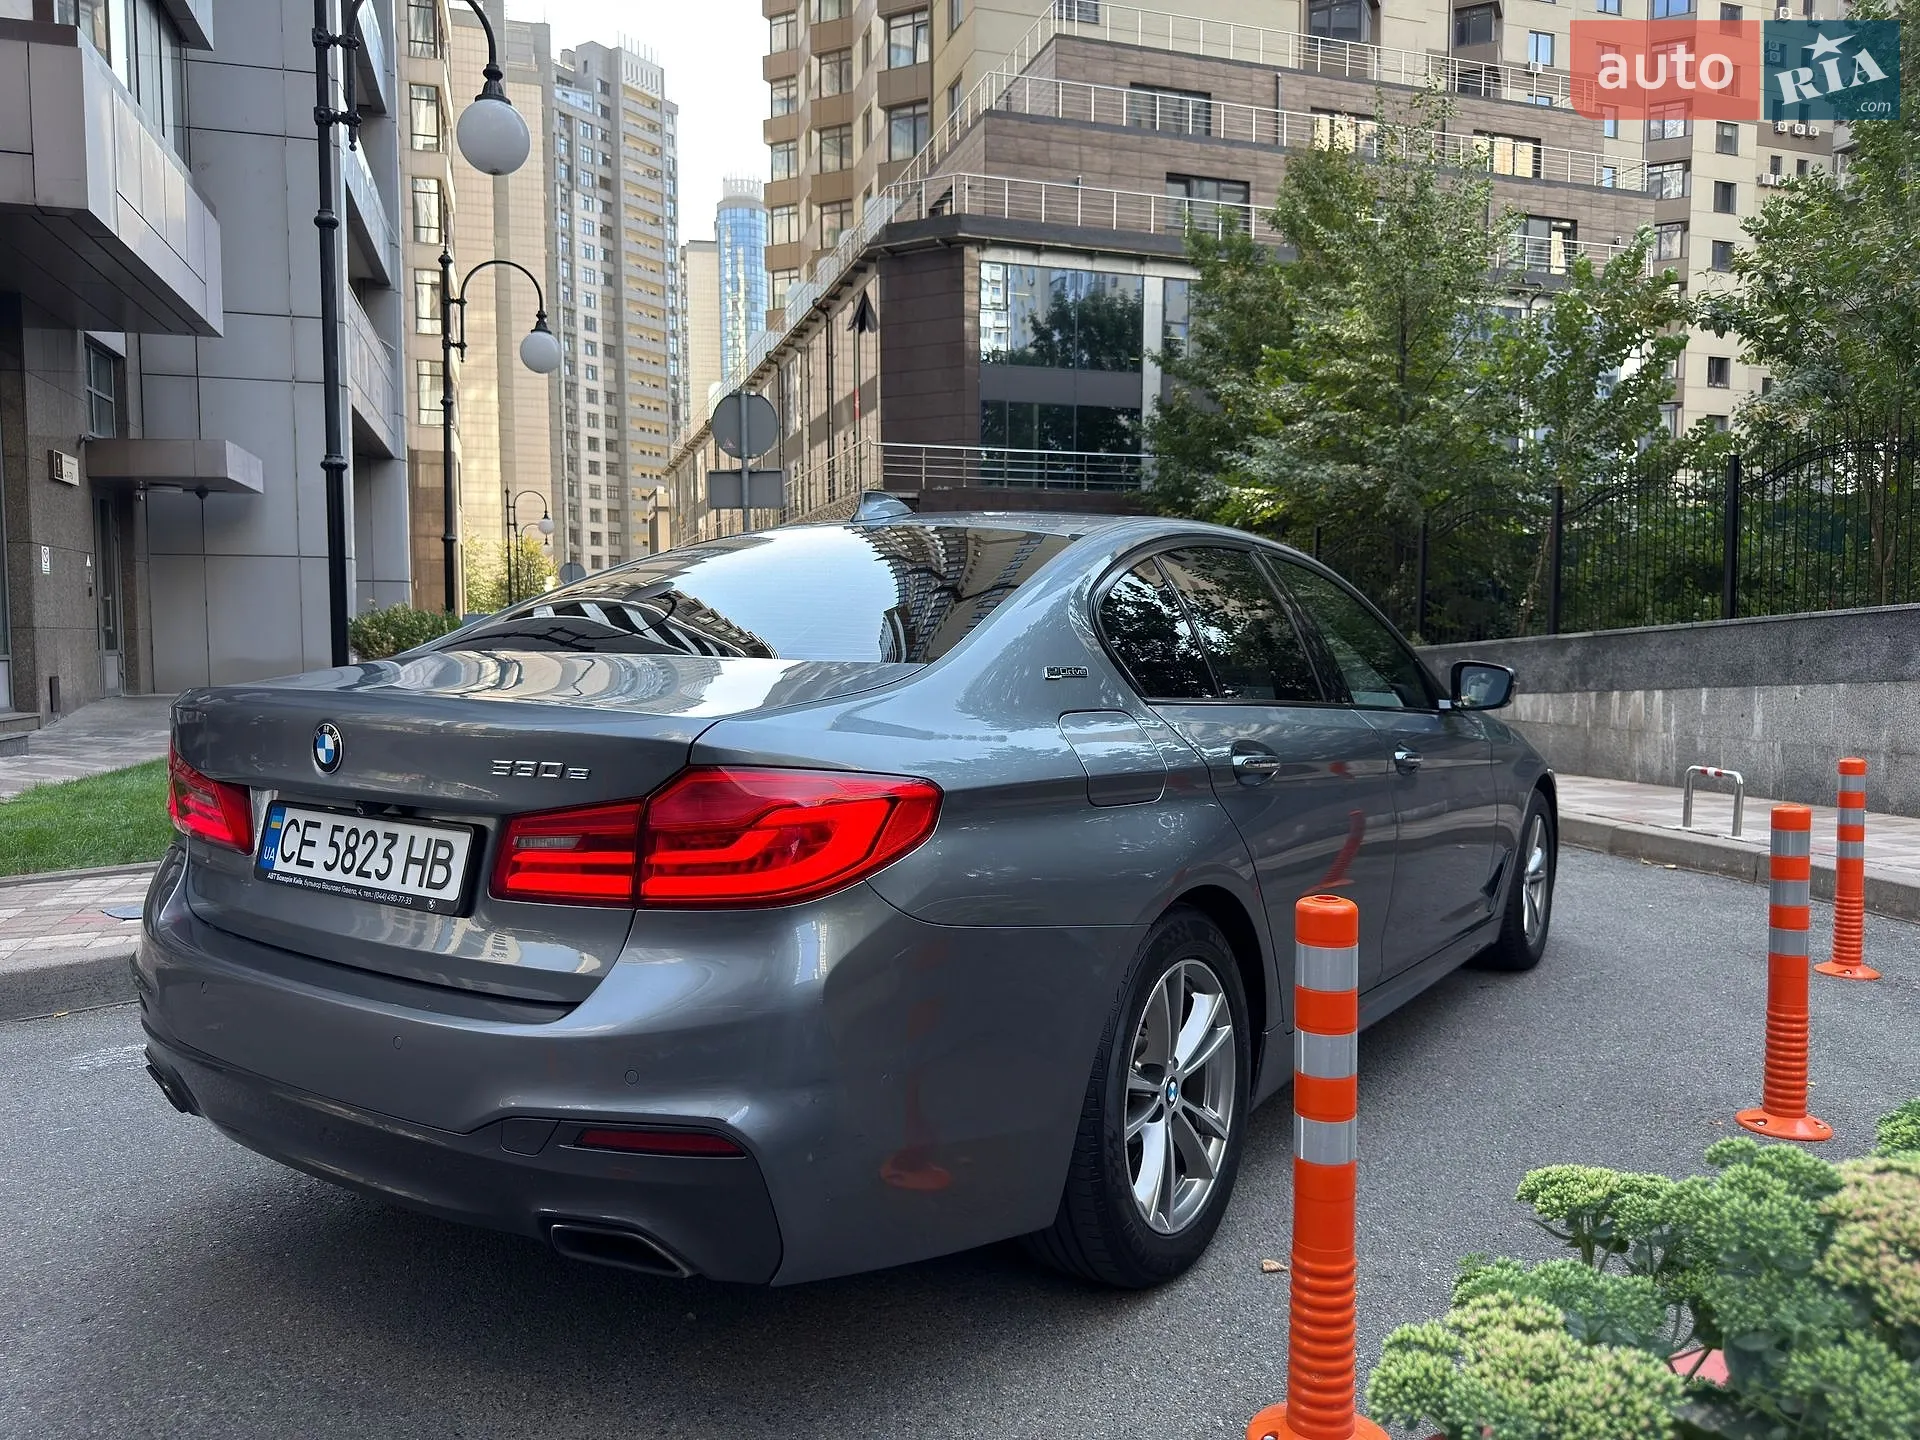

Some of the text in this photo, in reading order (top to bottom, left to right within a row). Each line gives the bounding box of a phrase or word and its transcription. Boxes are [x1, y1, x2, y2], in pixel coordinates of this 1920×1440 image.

[263, 846, 275, 862] UA
[280, 818, 455, 890] CE 5823 HB
